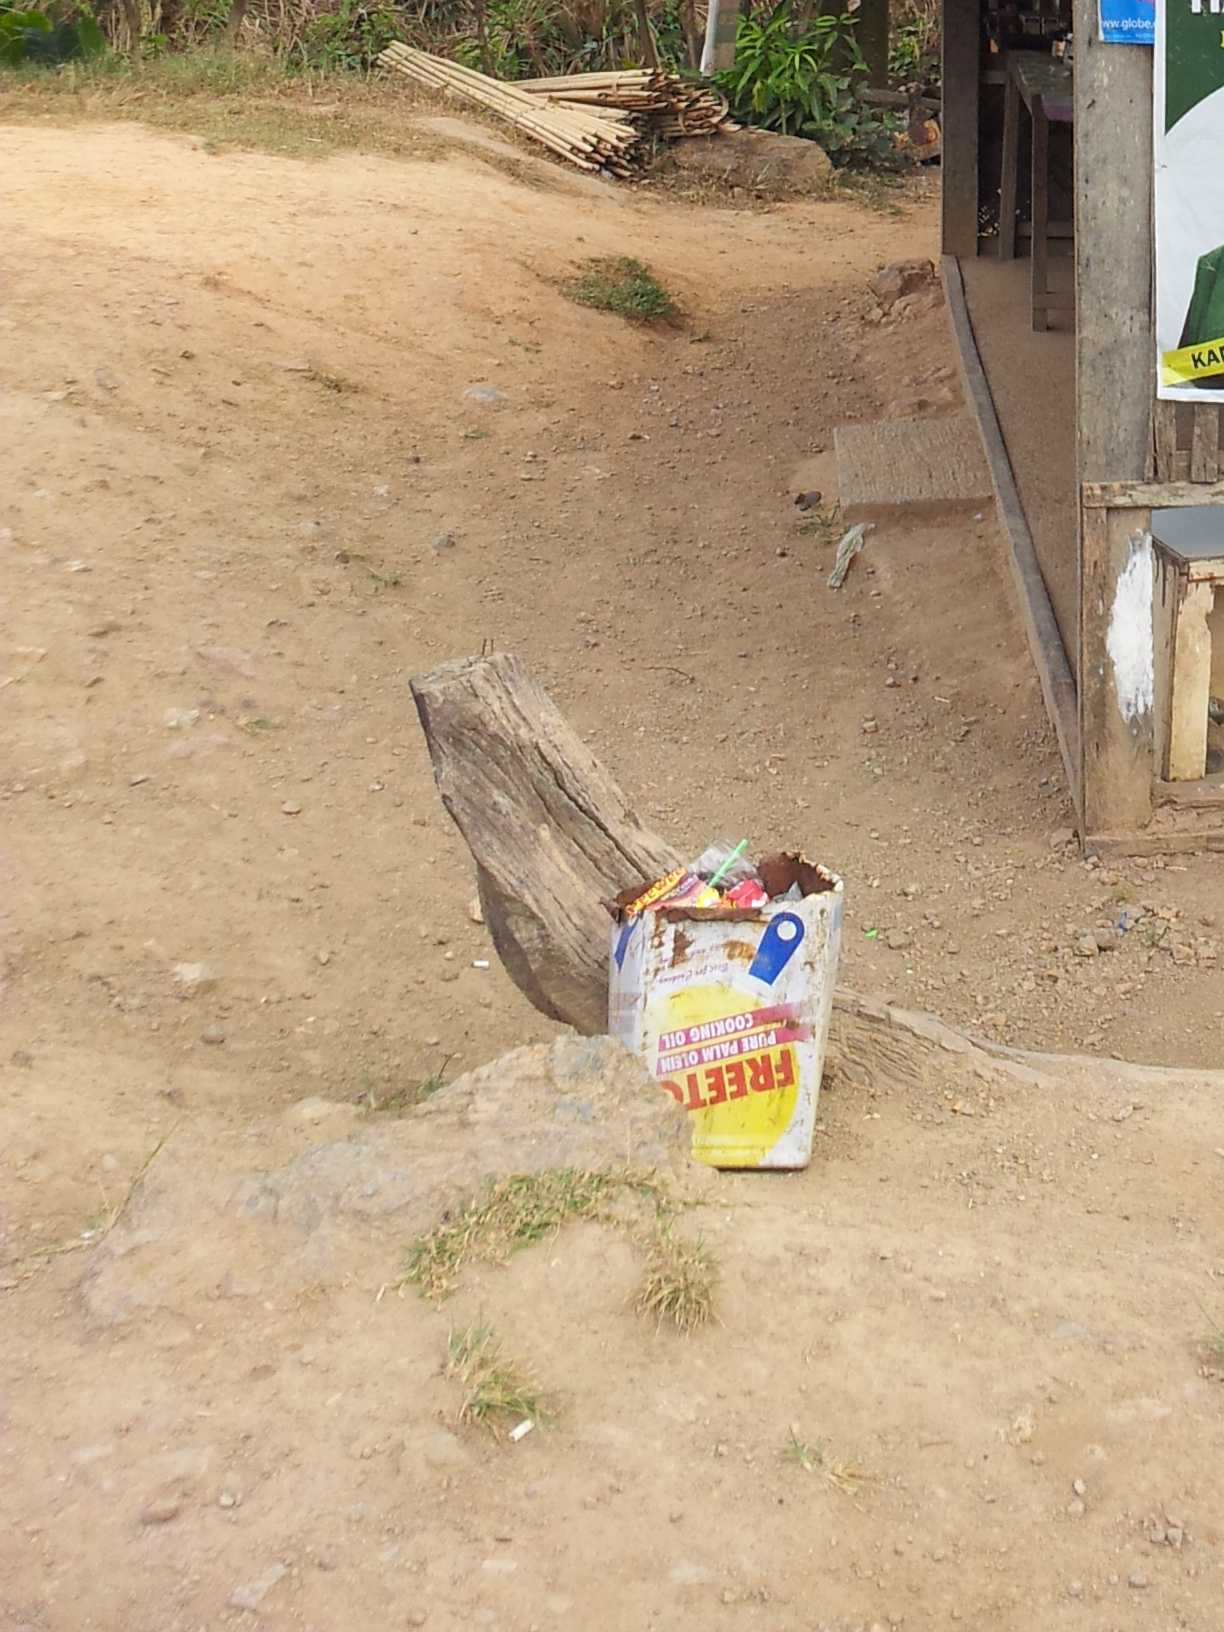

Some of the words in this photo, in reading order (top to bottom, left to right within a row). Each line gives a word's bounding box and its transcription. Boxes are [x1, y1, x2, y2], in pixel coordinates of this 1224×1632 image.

[690, 1013, 754, 1042] COOKING
[661, 1034, 686, 1050] OIL
[742, 1030, 777, 1049] PURE
[660, 1052, 698, 1073] OLEIN
[702, 1041, 739, 1063] PALM
